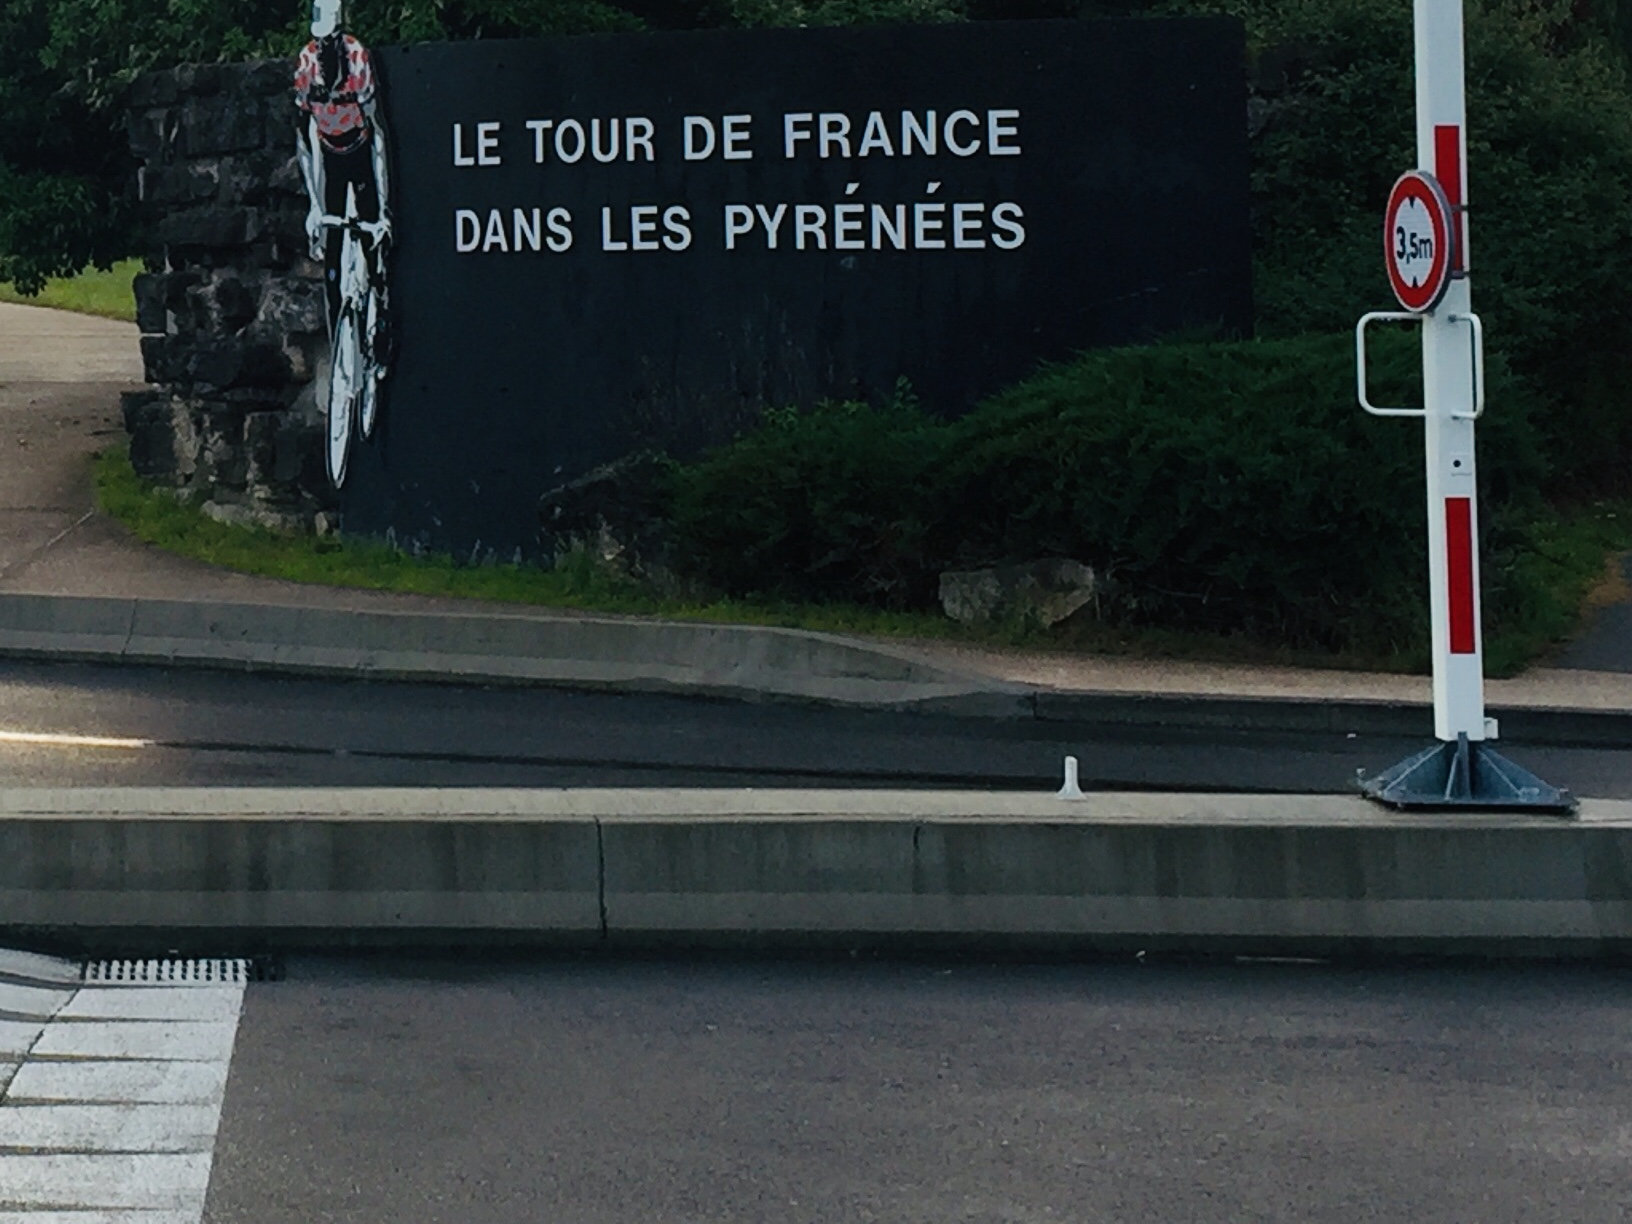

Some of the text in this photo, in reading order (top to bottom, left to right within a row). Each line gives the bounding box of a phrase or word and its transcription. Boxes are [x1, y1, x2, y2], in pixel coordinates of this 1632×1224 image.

[453, 109, 1021, 166] LE TOUR DE FRANCE
[455, 181, 1026, 252] DANS LES PYRÉNÉES
